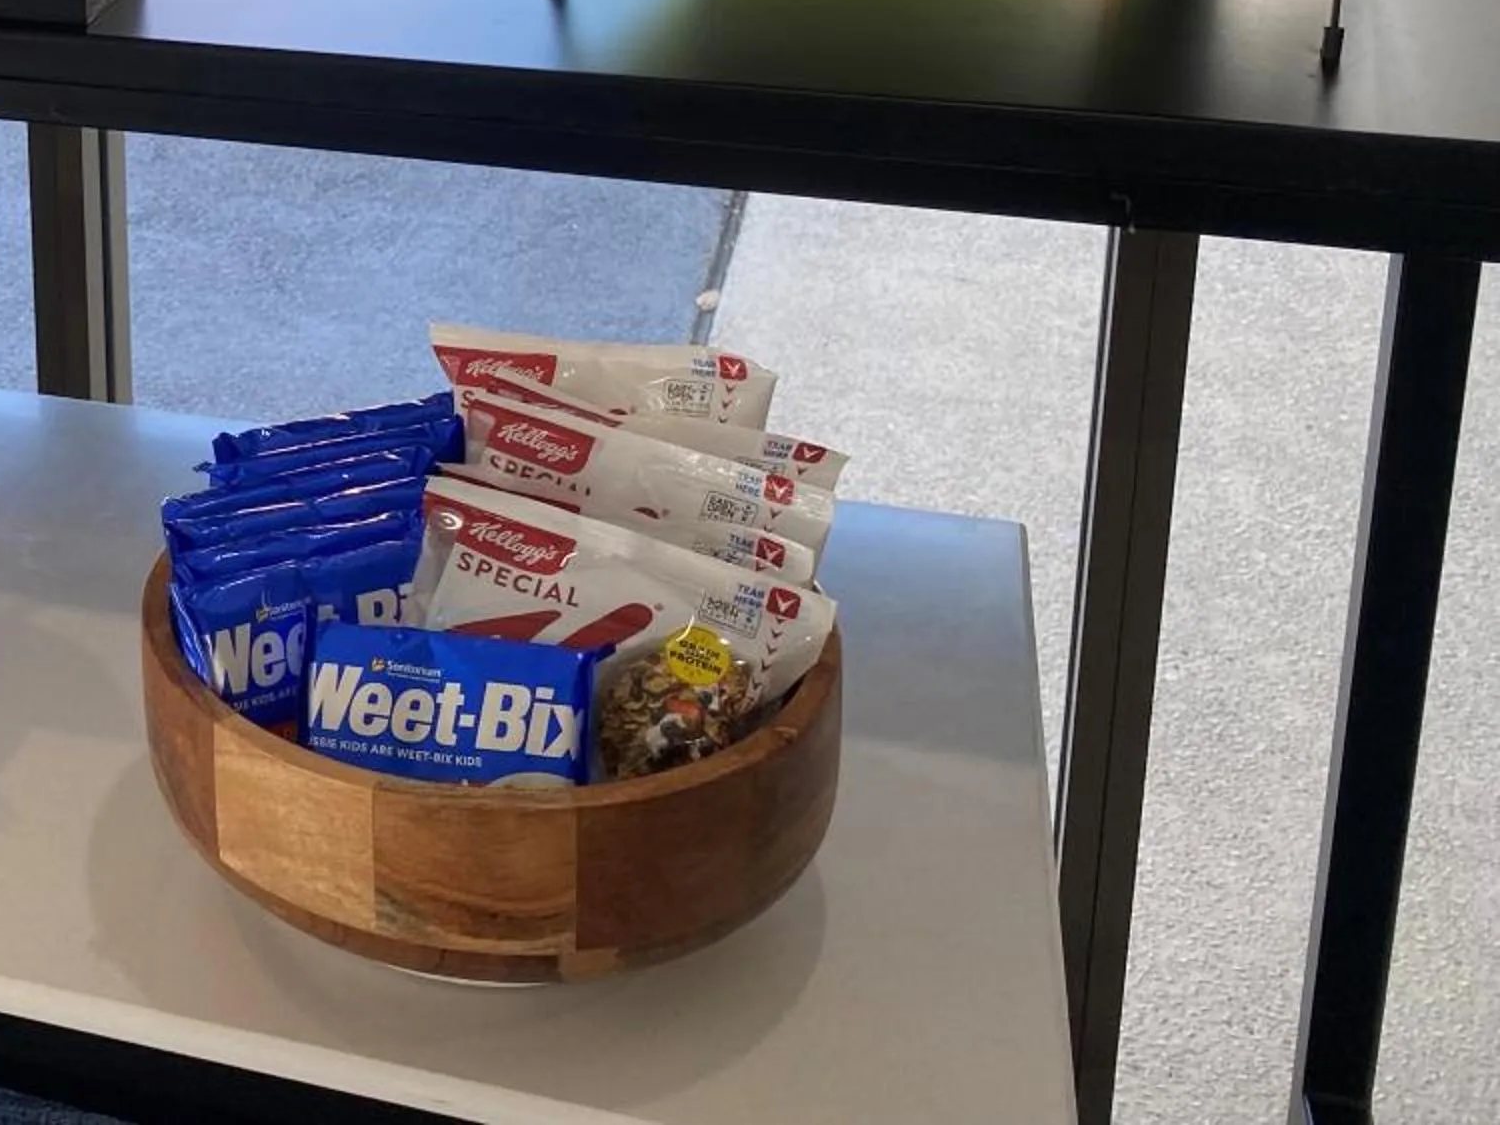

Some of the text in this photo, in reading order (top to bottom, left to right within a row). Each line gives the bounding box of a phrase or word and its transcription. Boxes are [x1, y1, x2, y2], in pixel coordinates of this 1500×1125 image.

[496, 422, 580, 462] Kellogg's
[468, 521, 556, 566] Kellogg's
[457, 551, 579, 608] SPECIAL
[308, 662, 583, 760] Weet-Bix
[339, 738, 368, 753] KIDS
[370, 744, 394, 757] ARE
[397, 748, 453, 765] WEET-BIX
[455, 754, 483, 769] KIDS
